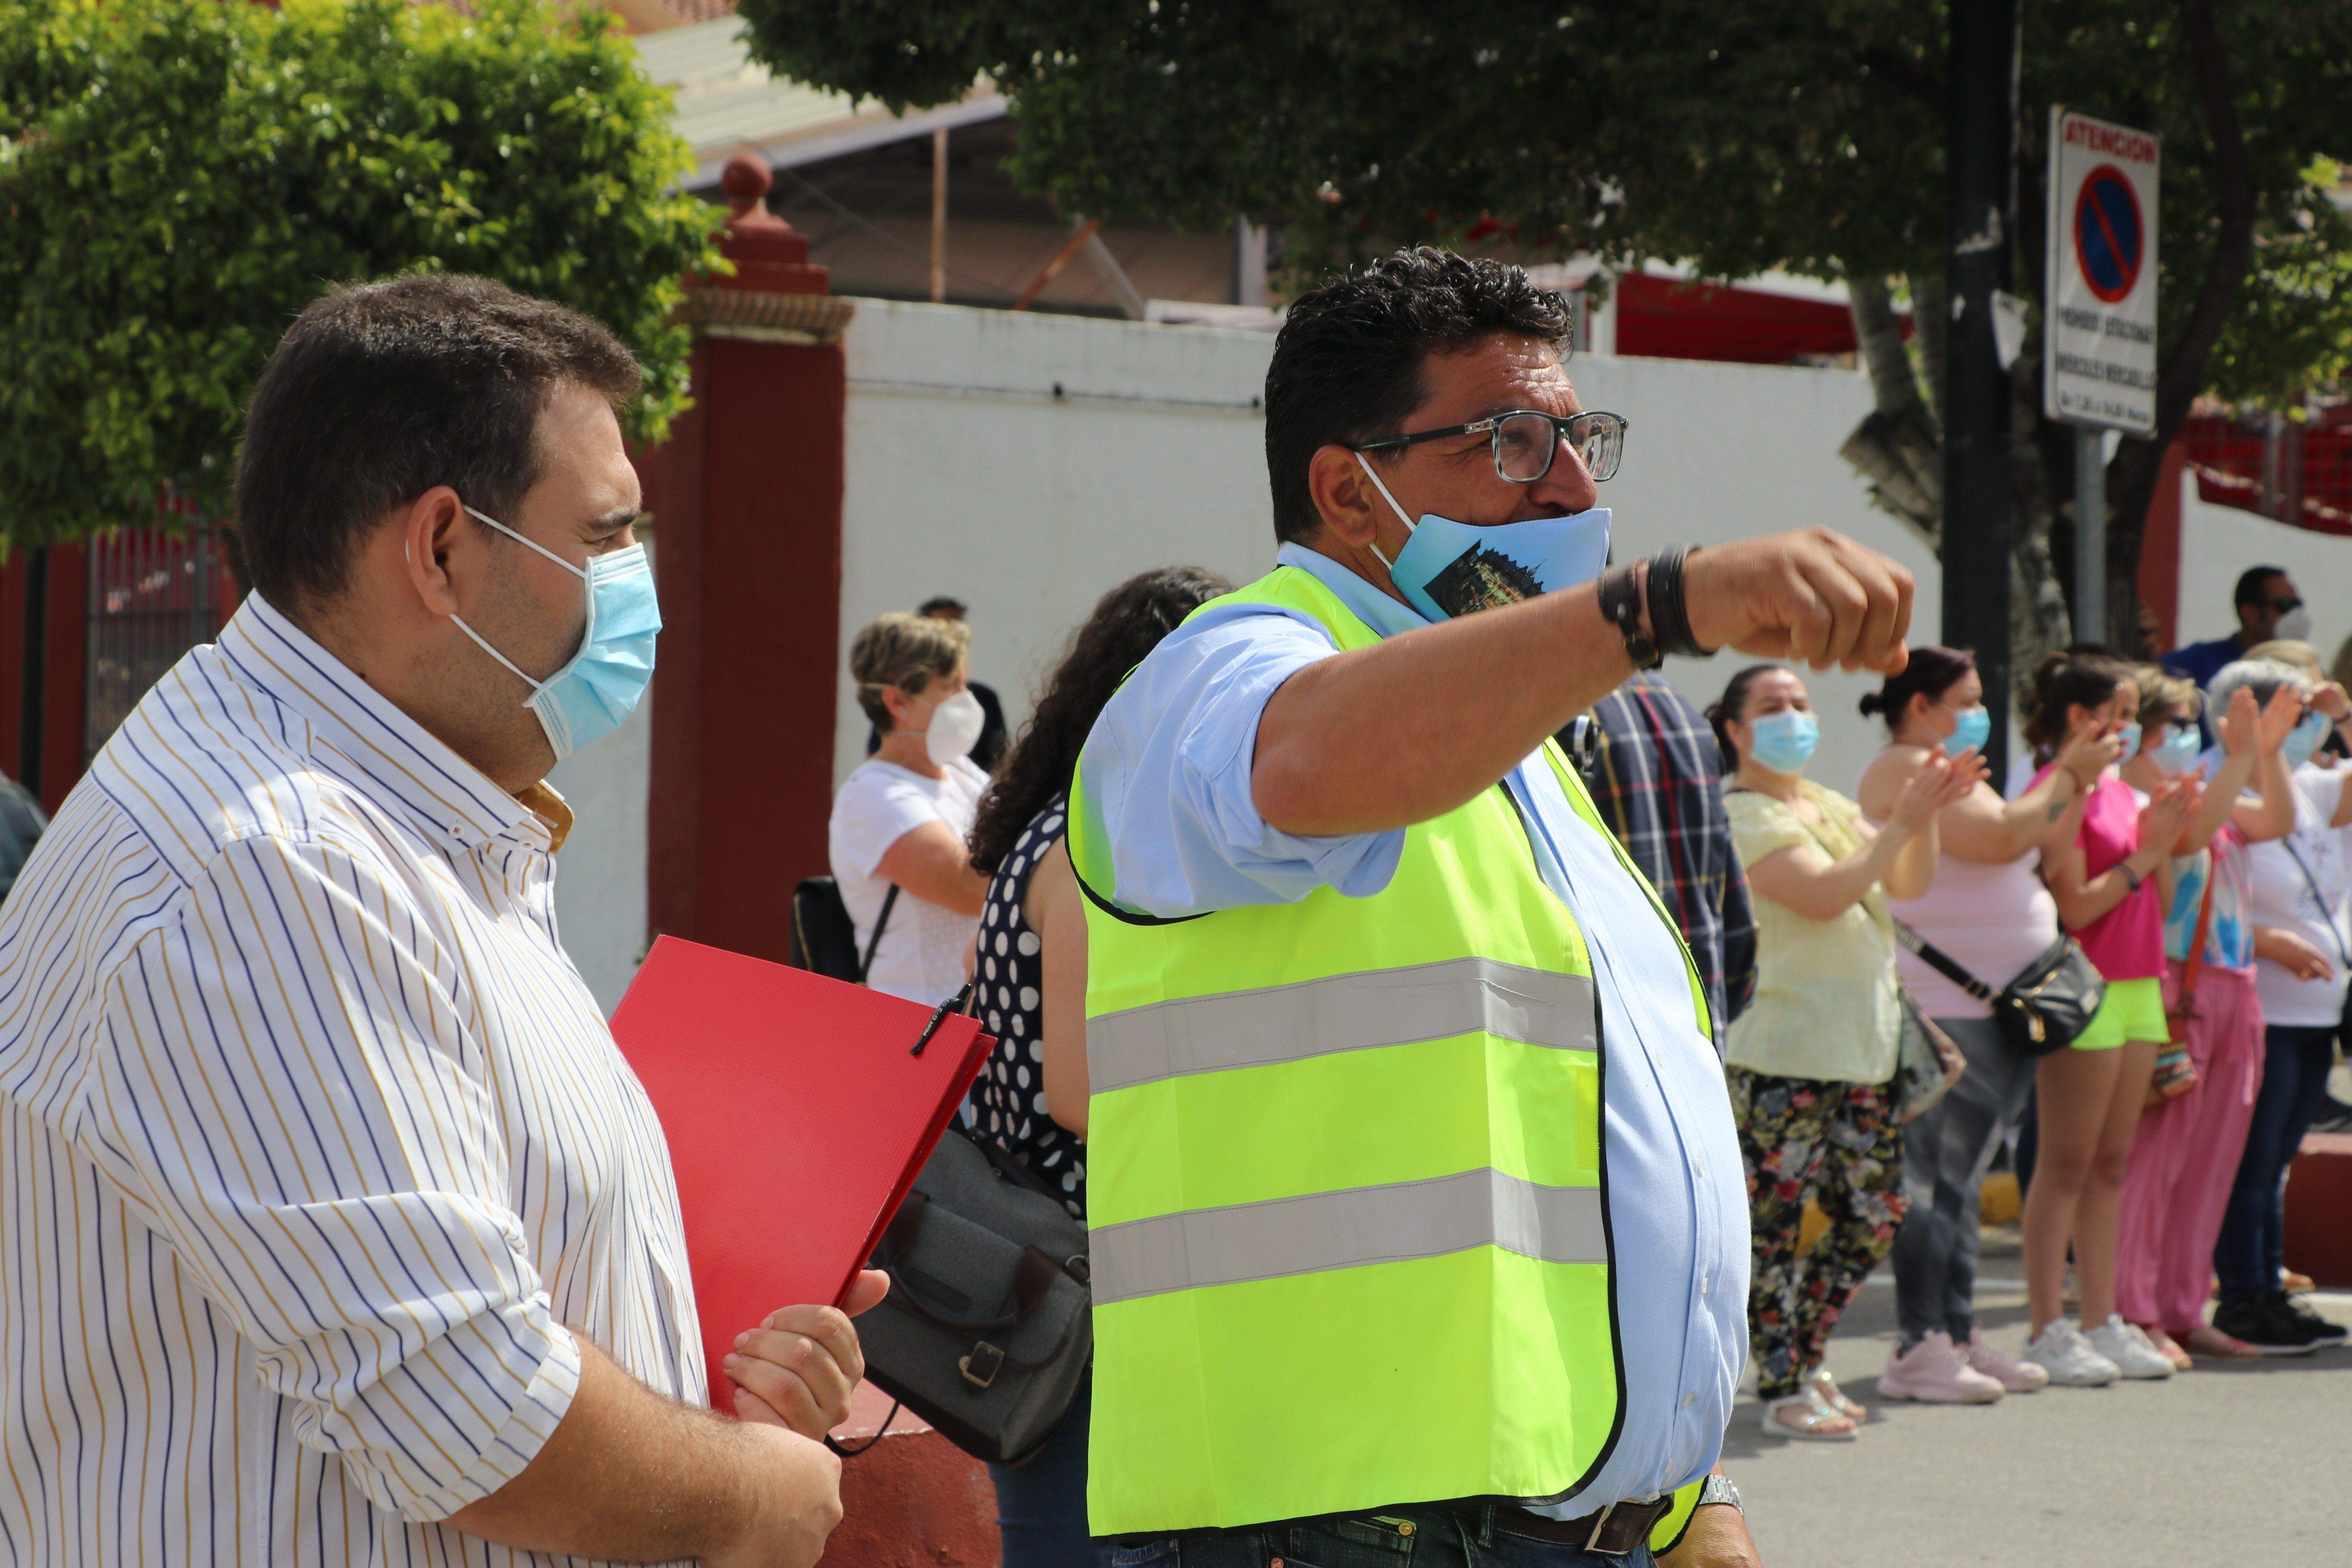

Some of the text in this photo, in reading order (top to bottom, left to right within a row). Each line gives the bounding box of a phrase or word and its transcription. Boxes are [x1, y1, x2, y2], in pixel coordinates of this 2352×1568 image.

[2065, 121, 2156, 165] ATENCION
[923, 1020, 934, 1036] PILOT
[932, 1007, 943, 1021] G-2
